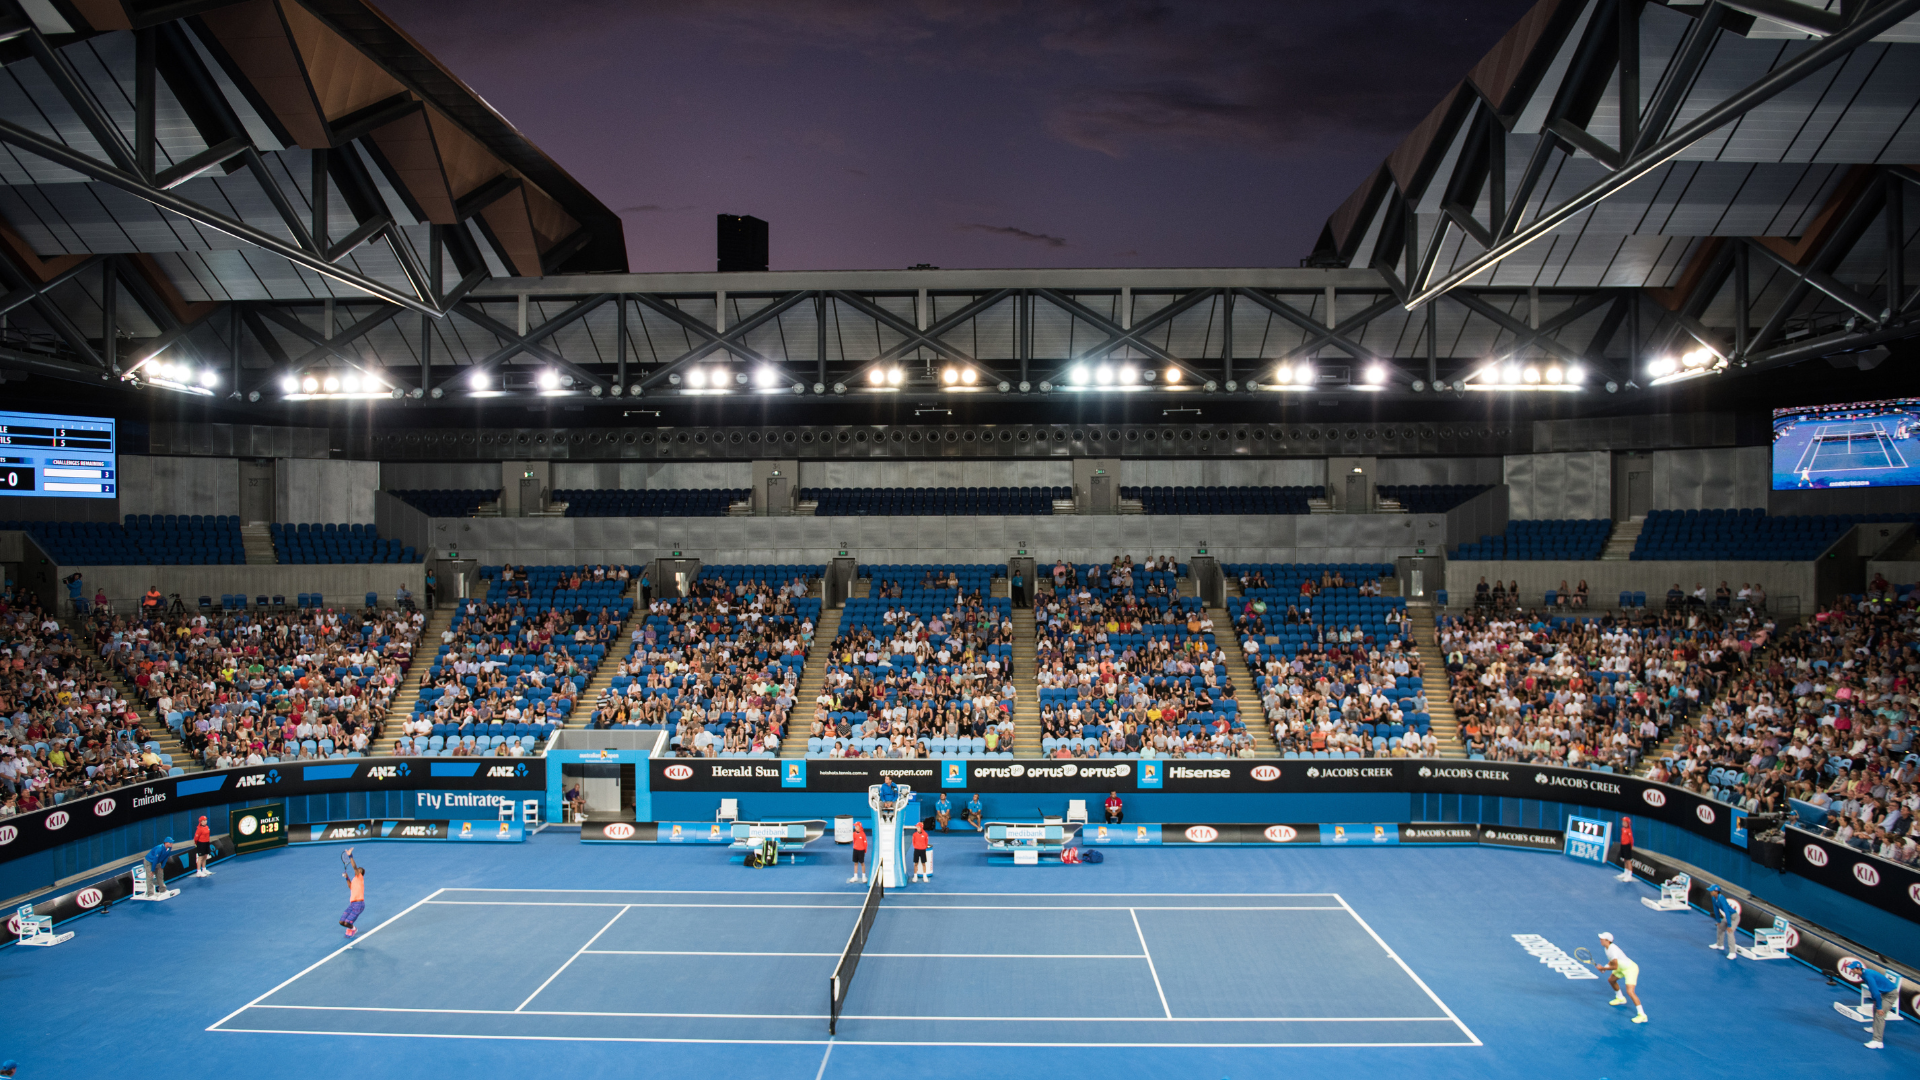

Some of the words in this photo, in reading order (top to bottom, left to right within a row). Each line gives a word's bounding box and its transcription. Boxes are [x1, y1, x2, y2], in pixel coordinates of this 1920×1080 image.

[367, 766, 396, 777] ANZ
[487, 766, 514, 777] ANZ
[712, 766, 752, 777] Herald
[755, 766, 779, 777] Sun
[975, 767, 1012, 778] OPTUS
[1027, 767, 1064, 778] OPTUS
[1080, 767, 1117, 778] OPTUS
[1169, 767, 1230, 778] Hisense
[1255, 769, 1276, 778] KIA
[1321, 767, 1359, 777] JACOB'S
[1361, 768, 1393, 777] CREEK
[1433, 768, 1472, 779] JACOB'S
[1475, 770, 1509, 781] CREEK
[235, 774, 265, 788] ANZ
[1549, 776, 1588, 789] JACOB'S
[1590, 782, 1620, 794] CREEK
[144, 788, 154, 798] Fly
[1646, 792, 1663, 804] KIA
[133, 792, 166, 808] Emirates
[418, 793, 441, 809] Fly
[444, 793, 505, 807] Emirates
[98, 801, 113, 814] KIA
[49, 813, 66, 827] KIA
[1700, 808, 1712, 821] KIA
[260, 822, 279, 834] 0:29
[330, 828, 355, 838] ANZ
[401, 826, 427, 836] ANZ
[610, 827, 630, 835] KIA
[751, 827, 786, 836] medibank
[1270, 828, 1291, 838] KIA
[1416, 829, 1446, 838] JACOB'S
[1448, 829, 1471, 838] CREEK
[1578, 821, 1598, 836] 171
[1191, 829, 1212, 839] KIA
[1497, 831, 1527, 843] JACOB'S
[1529, 834, 1556, 844] CREEK
[1570, 840, 1600, 861] IBM
[1808, 848, 1824, 863] KIA
[1641, 864, 1656, 877] CREEK
[1857, 866, 1875, 882] KIA
[80, 891, 101, 906] KIA
